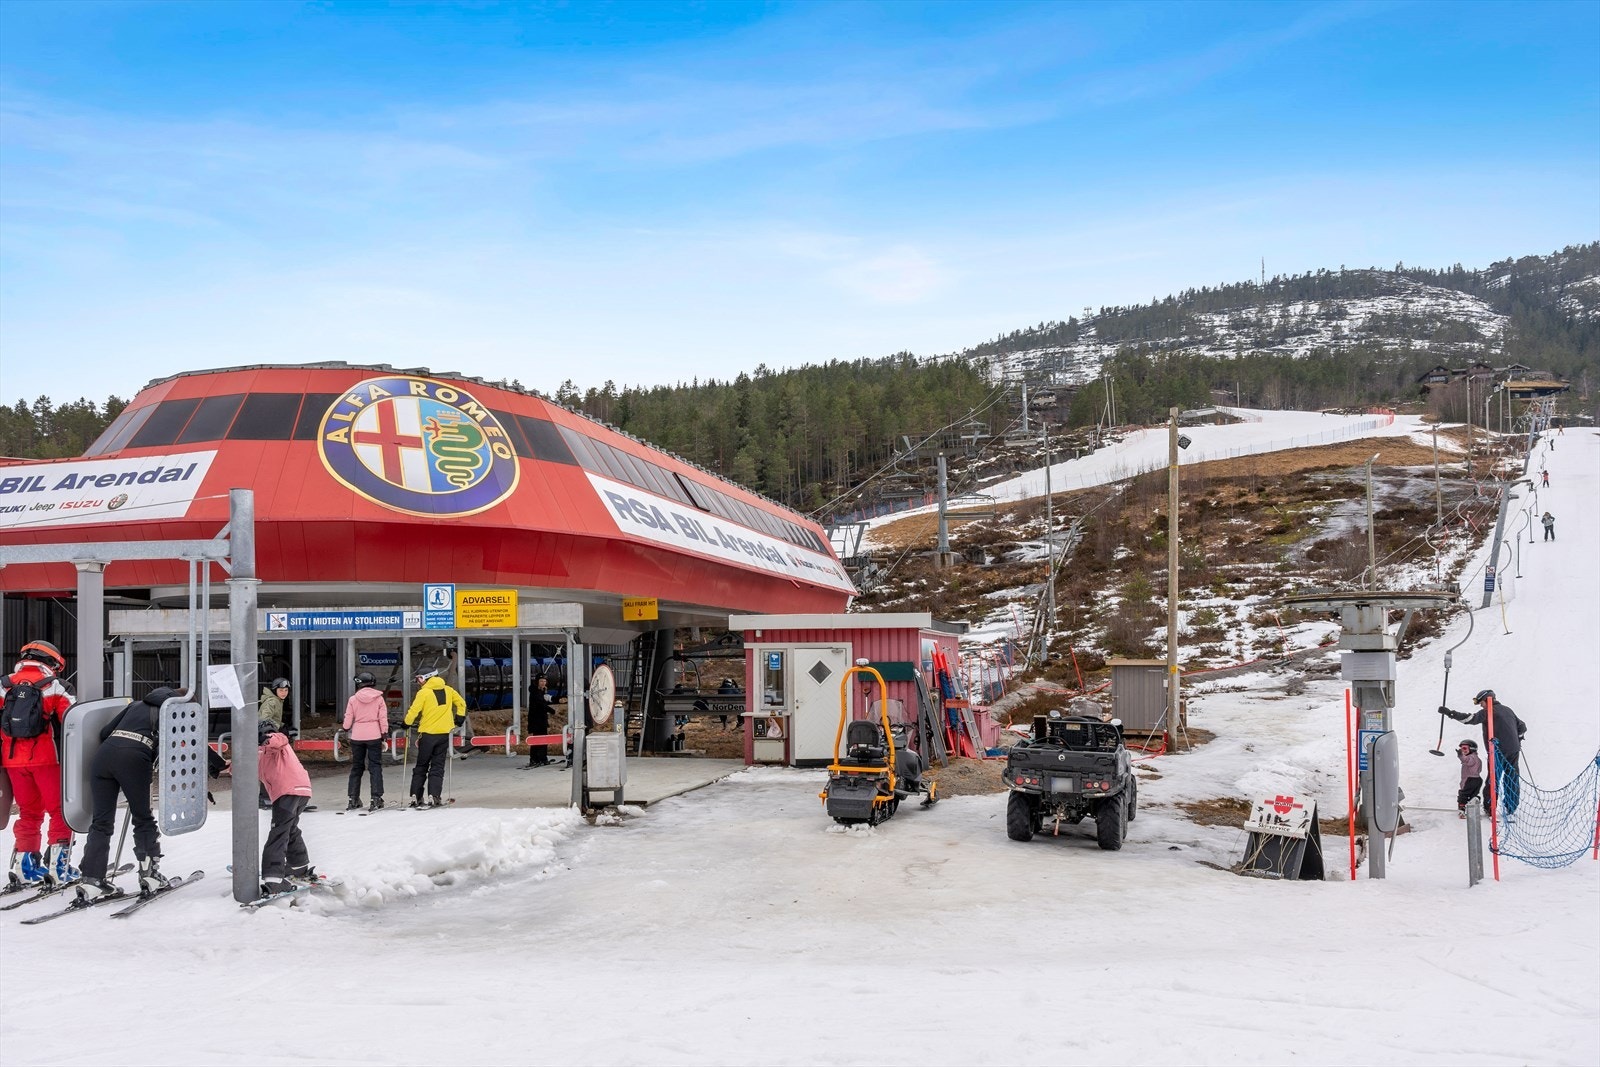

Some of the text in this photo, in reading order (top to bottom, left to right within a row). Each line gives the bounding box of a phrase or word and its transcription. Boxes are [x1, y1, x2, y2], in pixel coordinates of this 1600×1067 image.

[327, 380, 512, 460] ALFA ROMEO
[0, 462, 198, 494] BIL Arendal
[29, 502, 56, 512] Jeep
[59, 499, 104, 510] ISUZU
[603, 489, 788, 567] RSA BIL Arendal
[290, 616, 400, 625] SITT I MIDTEN AV STOLHEISEN
